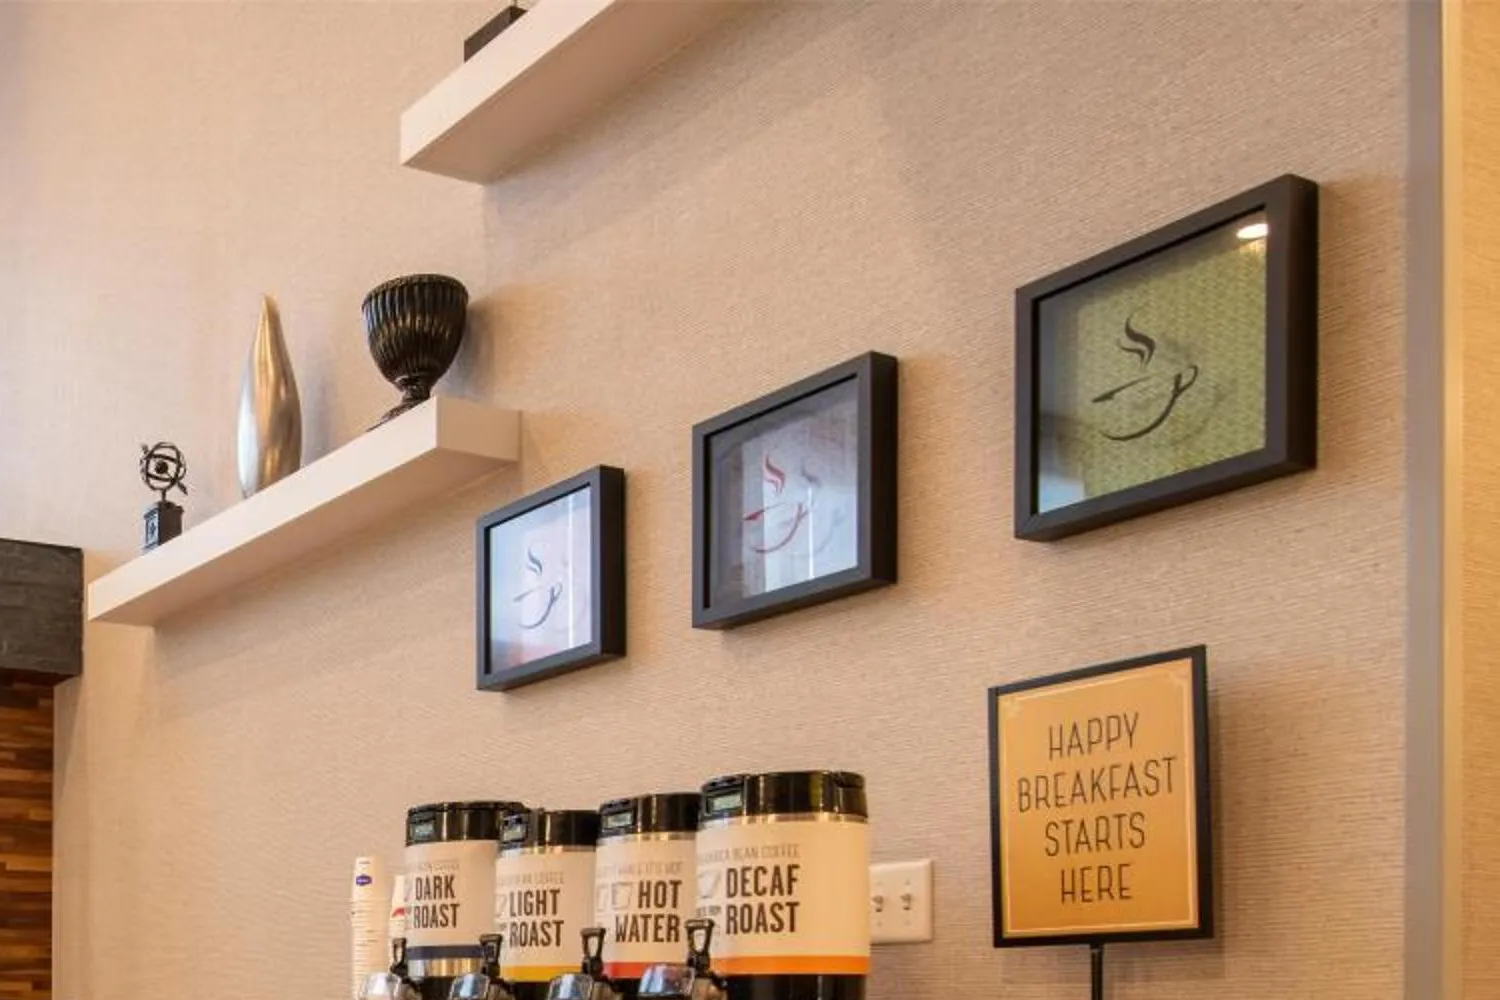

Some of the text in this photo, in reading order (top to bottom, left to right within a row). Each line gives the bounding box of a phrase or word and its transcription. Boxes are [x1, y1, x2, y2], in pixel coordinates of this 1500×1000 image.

[1048, 712, 1140, 760] HAPPY
[1017, 756, 1178, 813] BREAKFAST
[1044, 811, 1146, 857] STARTS
[415, 874, 456, 901] DARK
[637, 880, 682, 908] HOT
[726, 864, 800, 898] DECAF
[1060, 863, 1133, 904] HERE
[414, 903, 460, 928] ROAST
[509, 889, 561, 917] LIGHT
[726, 901, 800, 935] ROAST
[509, 920, 564, 948] ROAST
[615, 913, 680, 942] WATER
